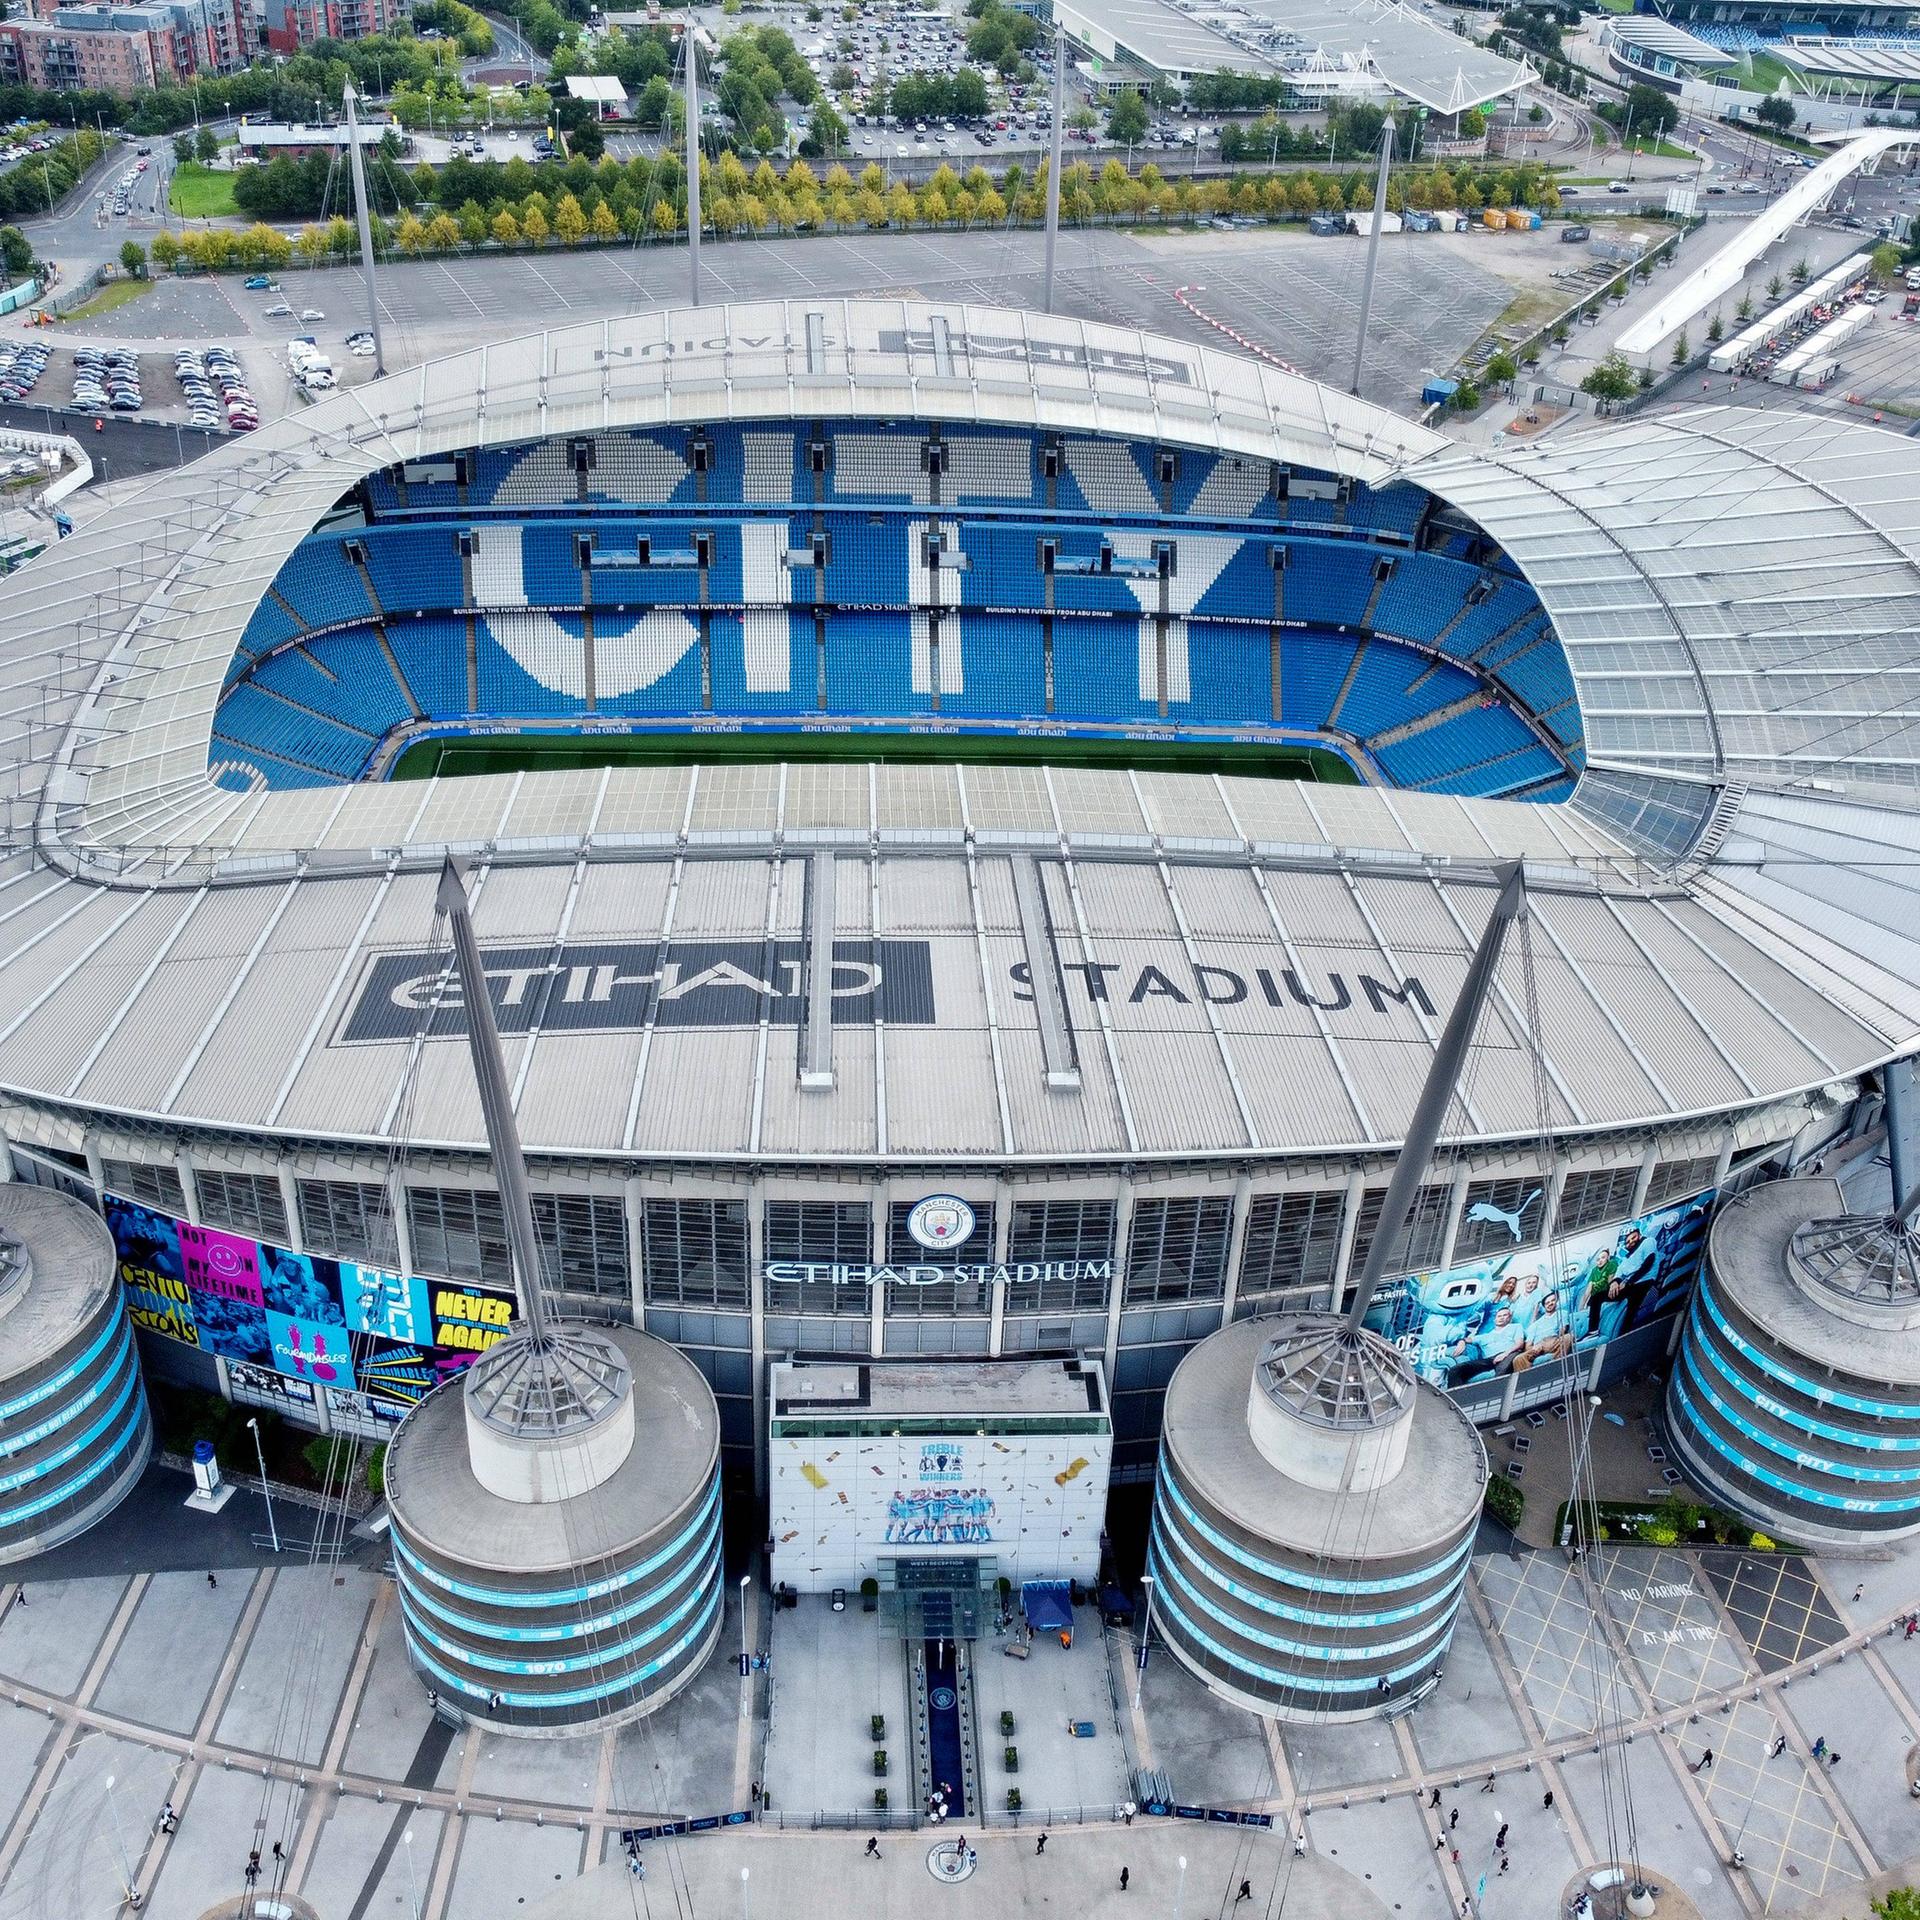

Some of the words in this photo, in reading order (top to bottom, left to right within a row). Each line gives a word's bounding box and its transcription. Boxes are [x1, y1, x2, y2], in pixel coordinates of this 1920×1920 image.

[470, 431, 1273, 703] CITY
[389, 959, 883, 1010] ETIHAD
[1008, 961, 1439, 1017] STADIUM
[915, 1200, 969, 1216] MANCHESTER
[181, 1226, 207, 1247] NOT
[765, 1263, 945, 1286] ETIHAD
[954, 1261, 1112, 1285] STADIUM
[189, 1270, 258, 1304] LIFETIME
[435, 1291, 513, 1327] NEVER
[1395, 1333, 1416, 1351] OF
[1721, 1324, 1748, 1350] CITY
[1755, 1394, 1790, 1417] CITY
[920, 1444, 964, 1457] TREBLE
[1796, 1454, 1836, 1472] CITY
[919, 1472, 964, 1482] WINNERS
[1843, 1500, 1881, 1512] CITY
[587, 1574, 629, 1598] 2022
[1620, 1588, 1642, 1601] NO
[1647, 1583, 1694, 1600] PARKING
[1642, 1631, 1658, 1646] AT
[1663, 1629, 1686, 1643] ANY
[1686, 1626, 1718, 1641] TIME
